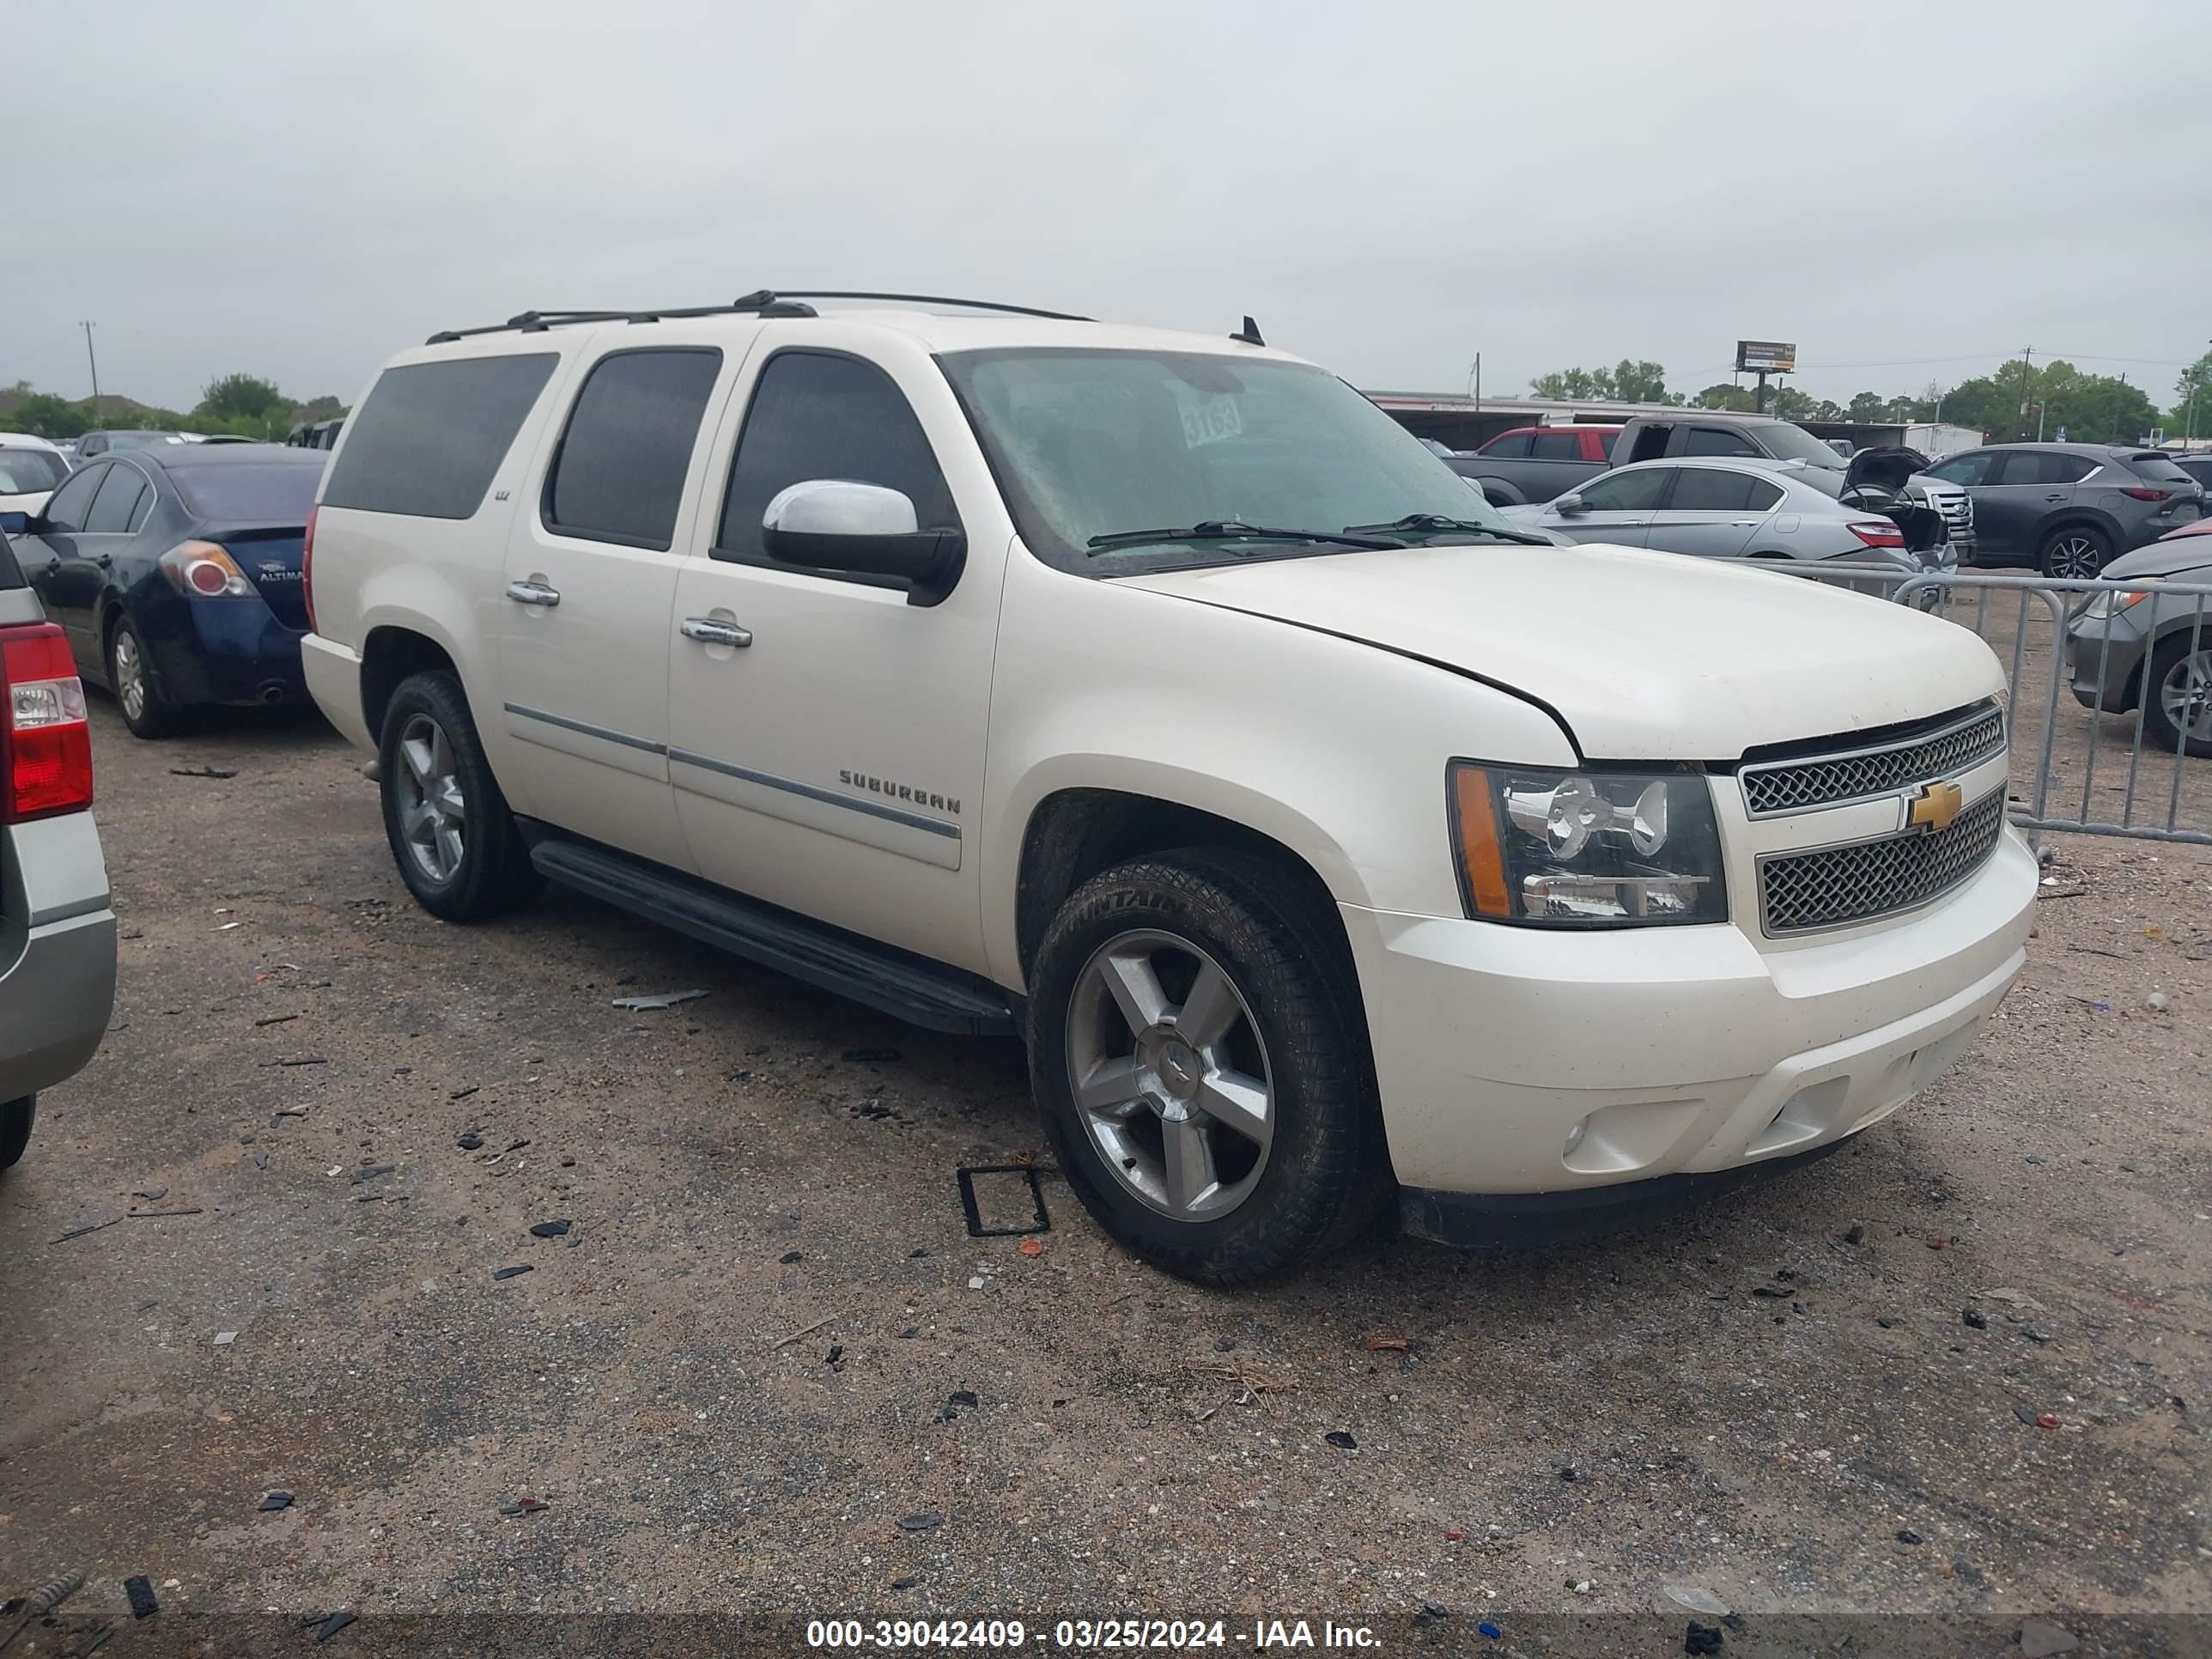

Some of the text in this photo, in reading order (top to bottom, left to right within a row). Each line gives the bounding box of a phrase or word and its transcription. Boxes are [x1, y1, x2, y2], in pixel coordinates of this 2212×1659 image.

[1184, 404, 1237, 441] 3163
[260, 571, 304, 582] ALTIMA
[839, 769, 962, 814] SUBURBAN
